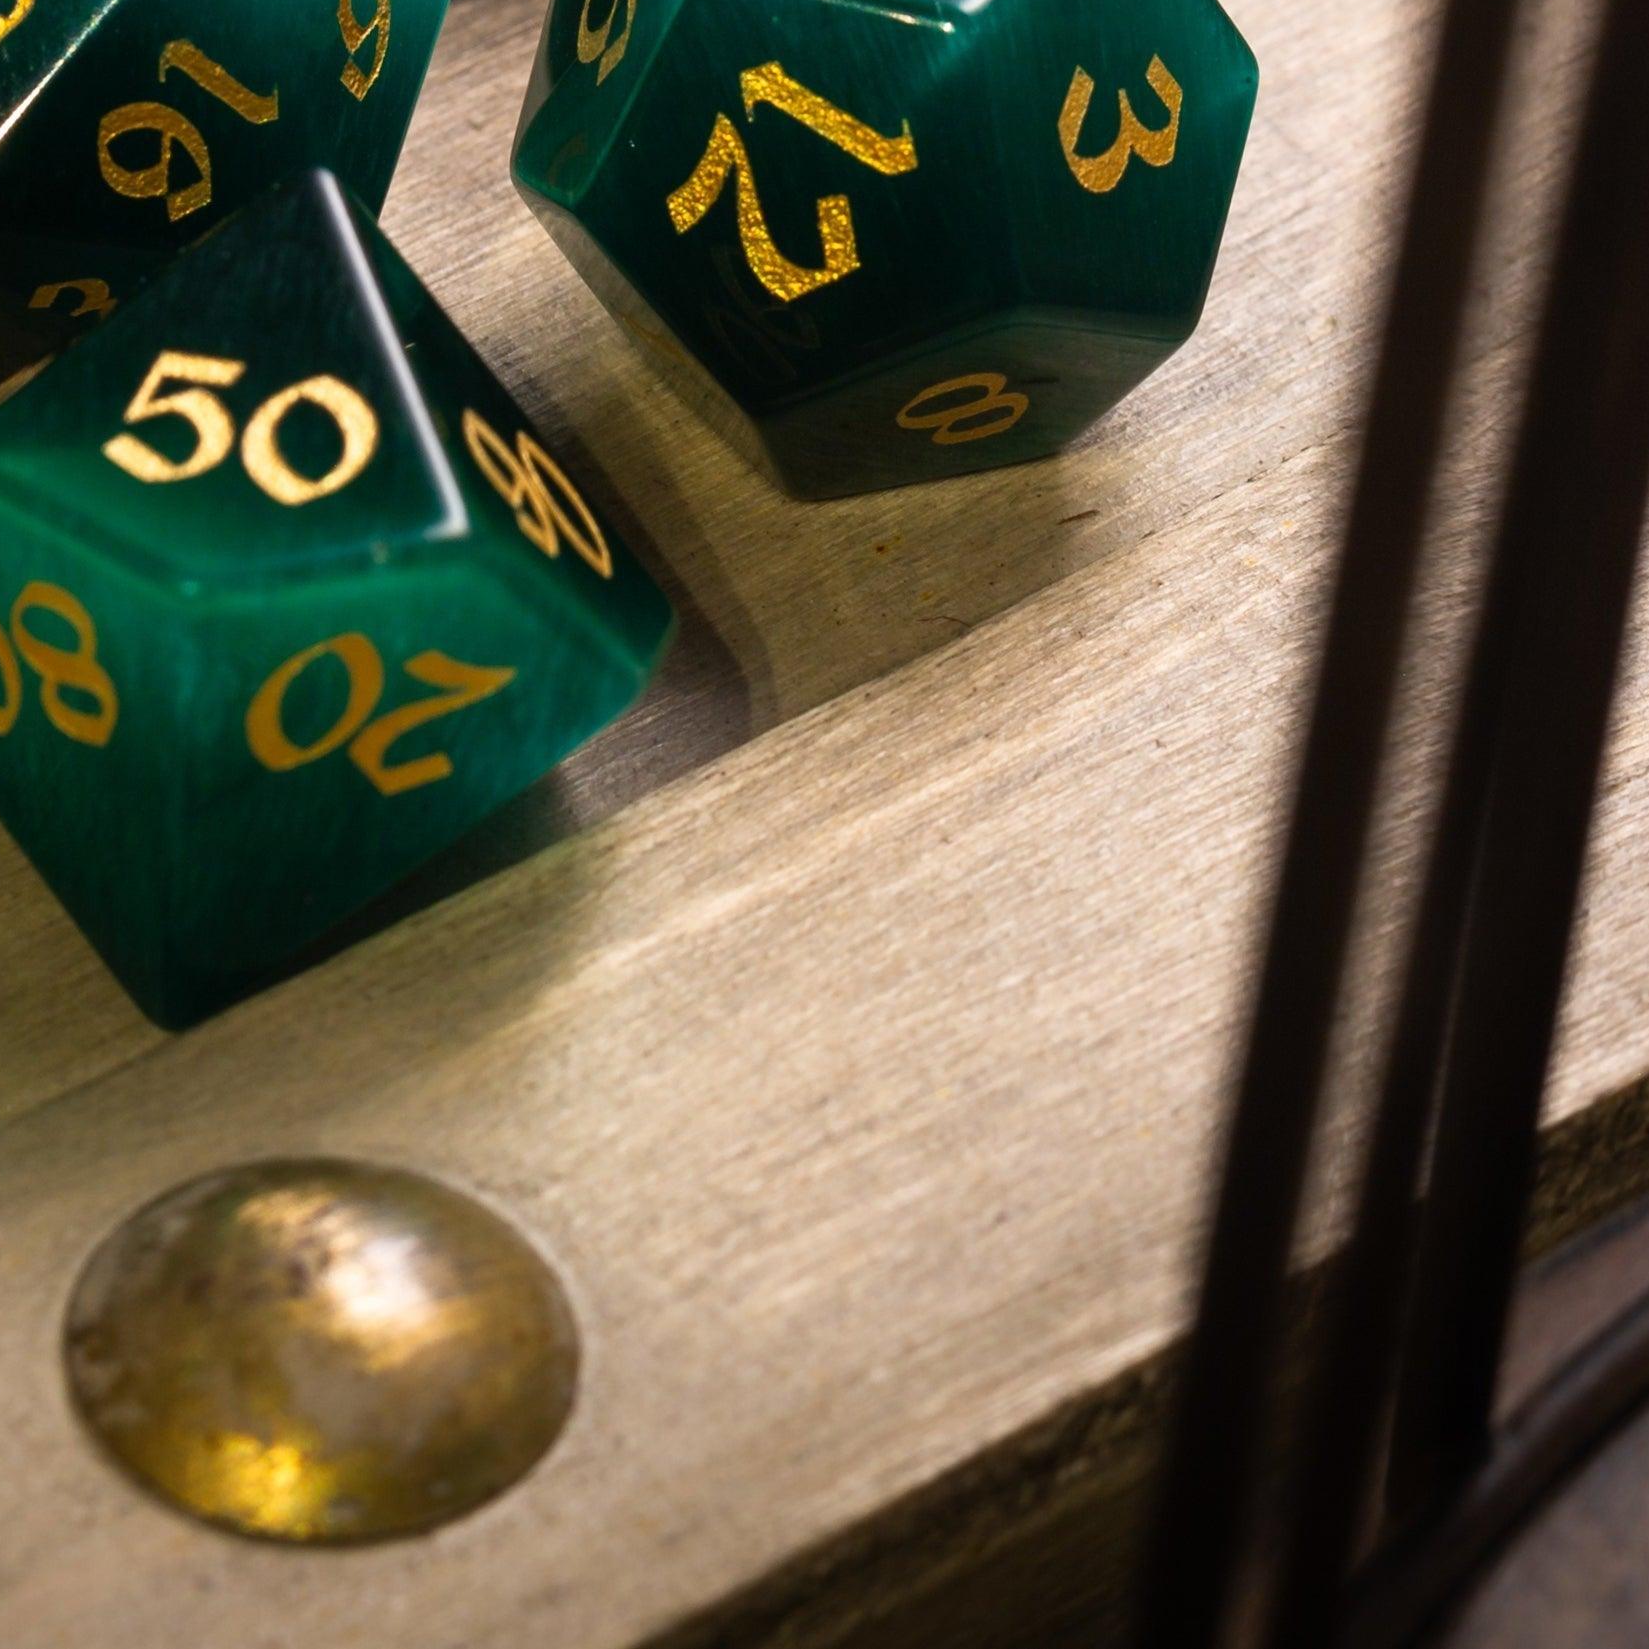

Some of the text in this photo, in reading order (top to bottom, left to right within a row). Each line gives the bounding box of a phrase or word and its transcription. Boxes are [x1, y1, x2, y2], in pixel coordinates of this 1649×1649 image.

[97, 40, 279, 222] 16
[665, 61, 919, 304] 12
[1056, 54, 1184, 195] 3
[102, 350, 381, 506] 50
[895, 372, 1030, 446] 8
[245, 632, 517, 797] 20
